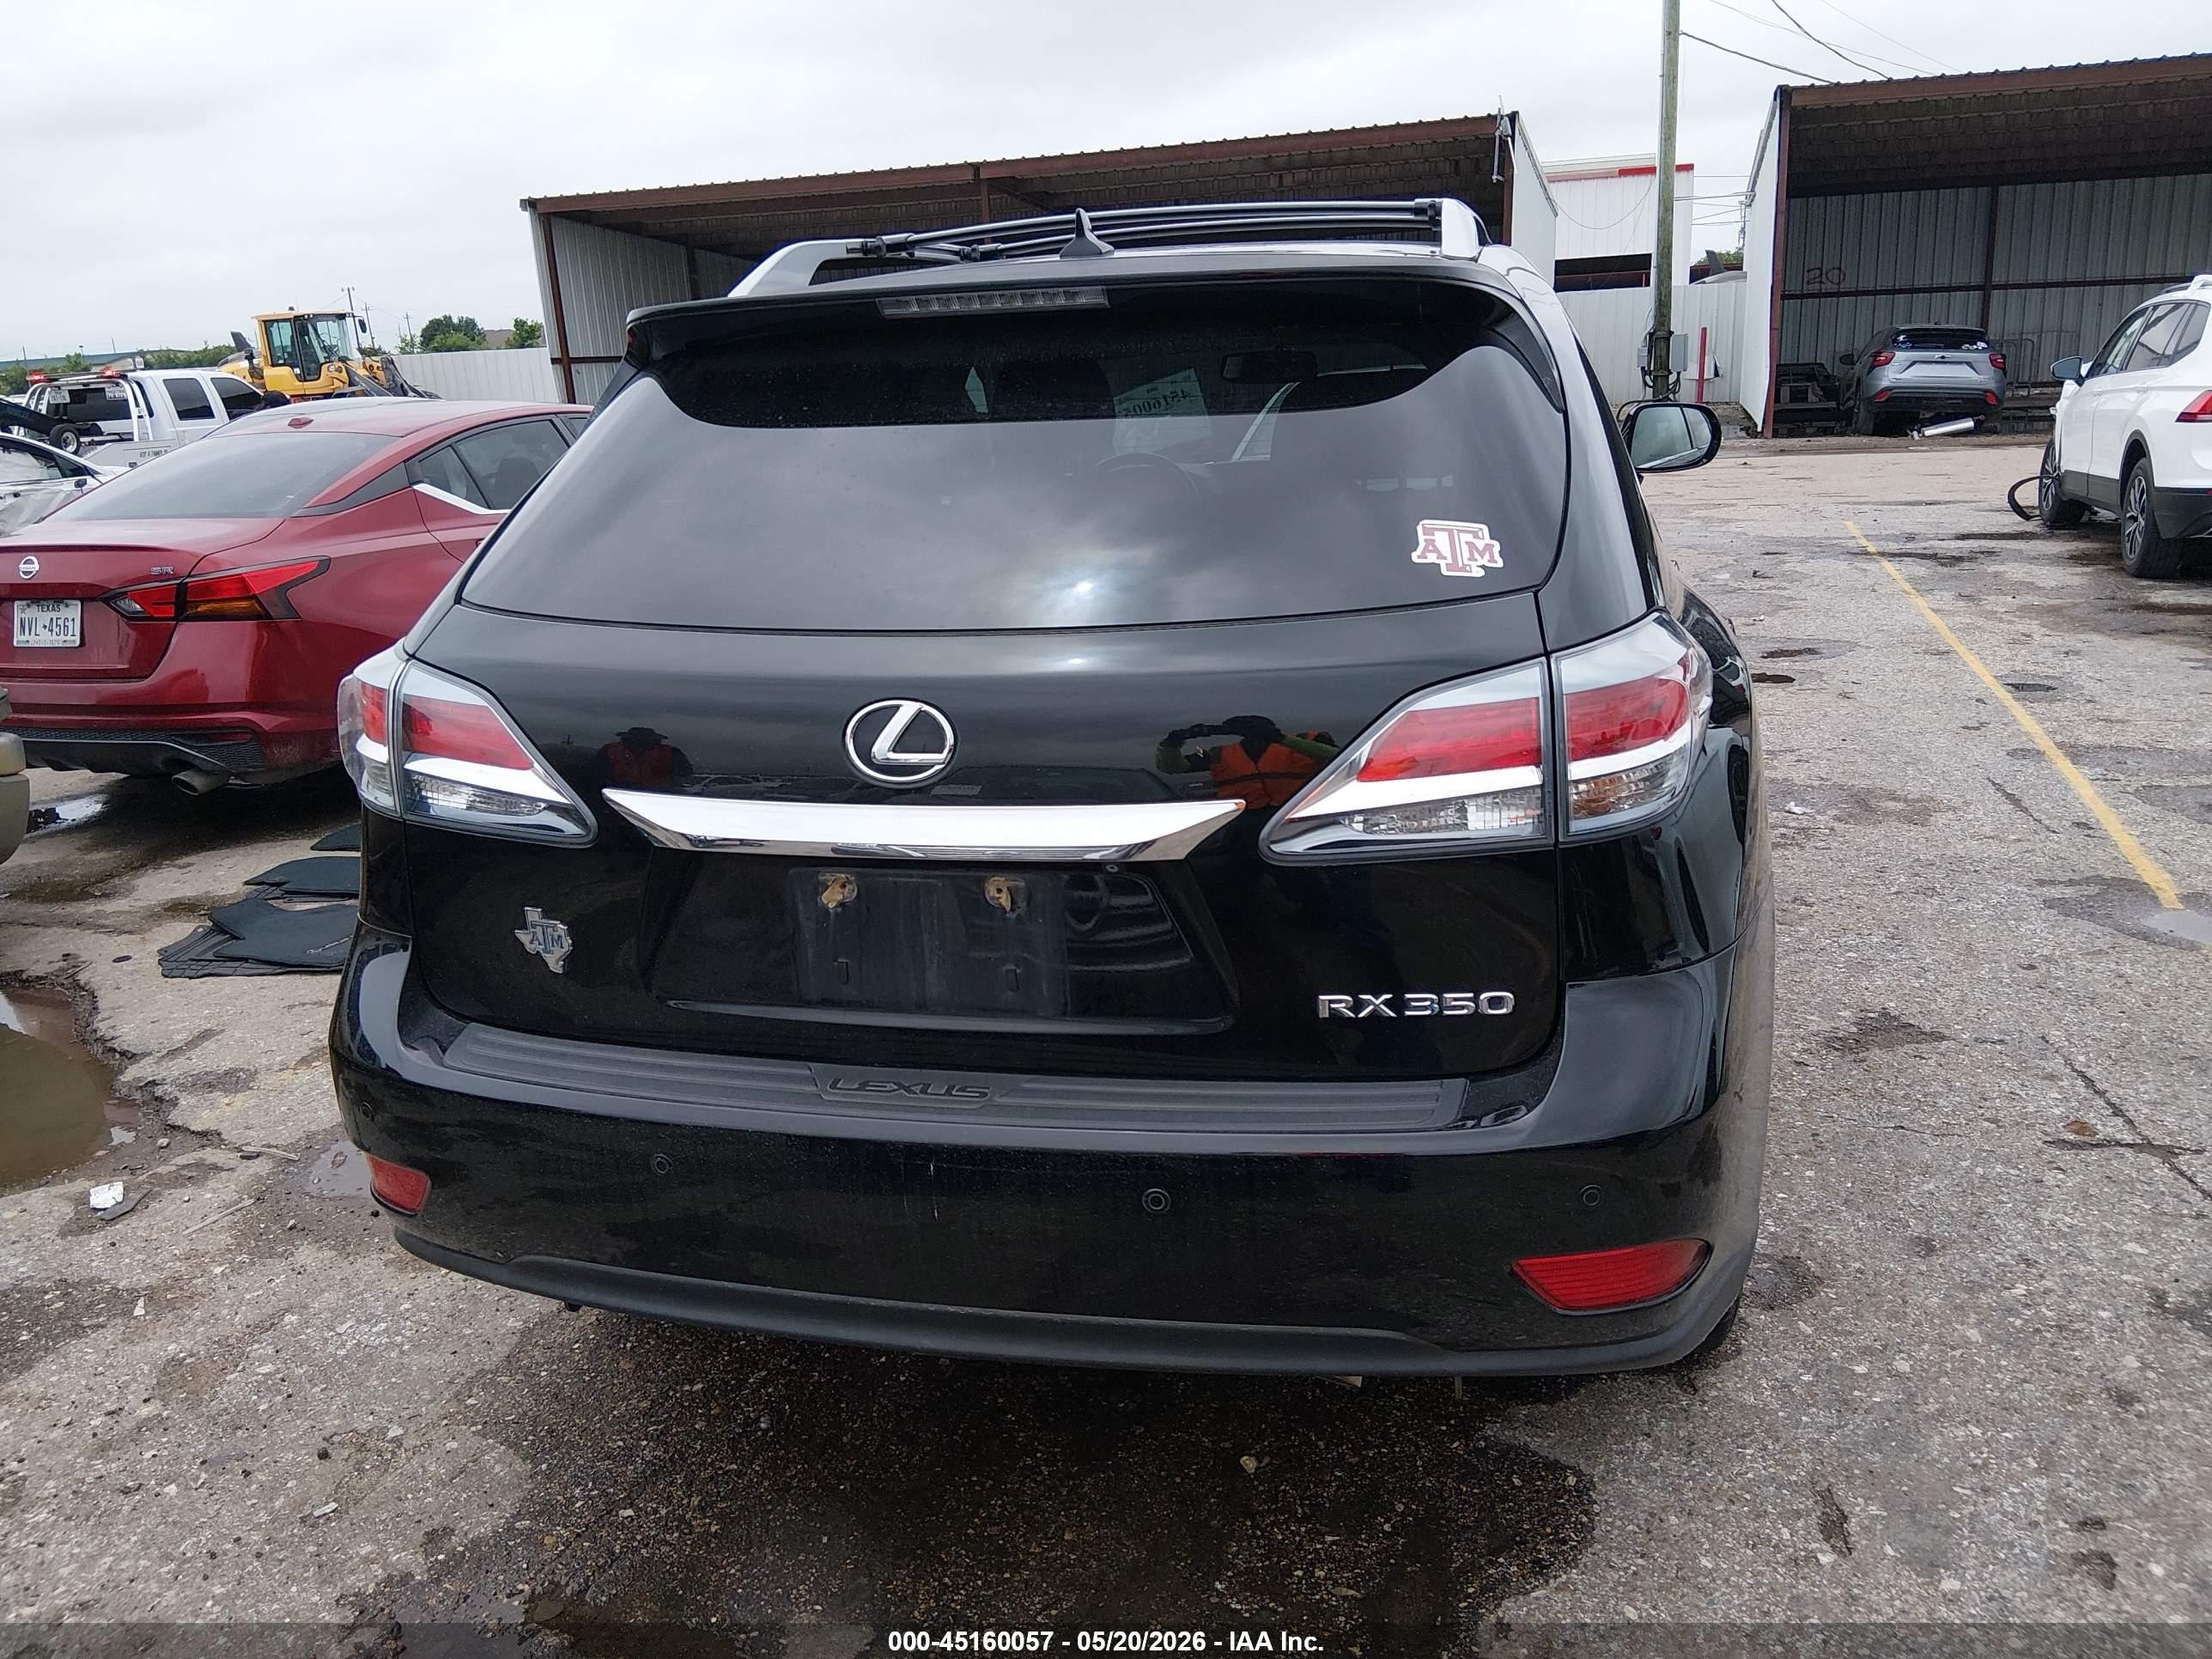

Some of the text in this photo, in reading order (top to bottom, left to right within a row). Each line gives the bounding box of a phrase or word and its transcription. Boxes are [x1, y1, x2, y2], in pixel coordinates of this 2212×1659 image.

[1807, 267, 1846, 285] 20
[150, 566, 173, 574] SR
[36, 604, 61, 613] TEXAS
[1318, 991, 1516, 1018] RX 350
[828, 1078, 990, 1099] LEXUS
